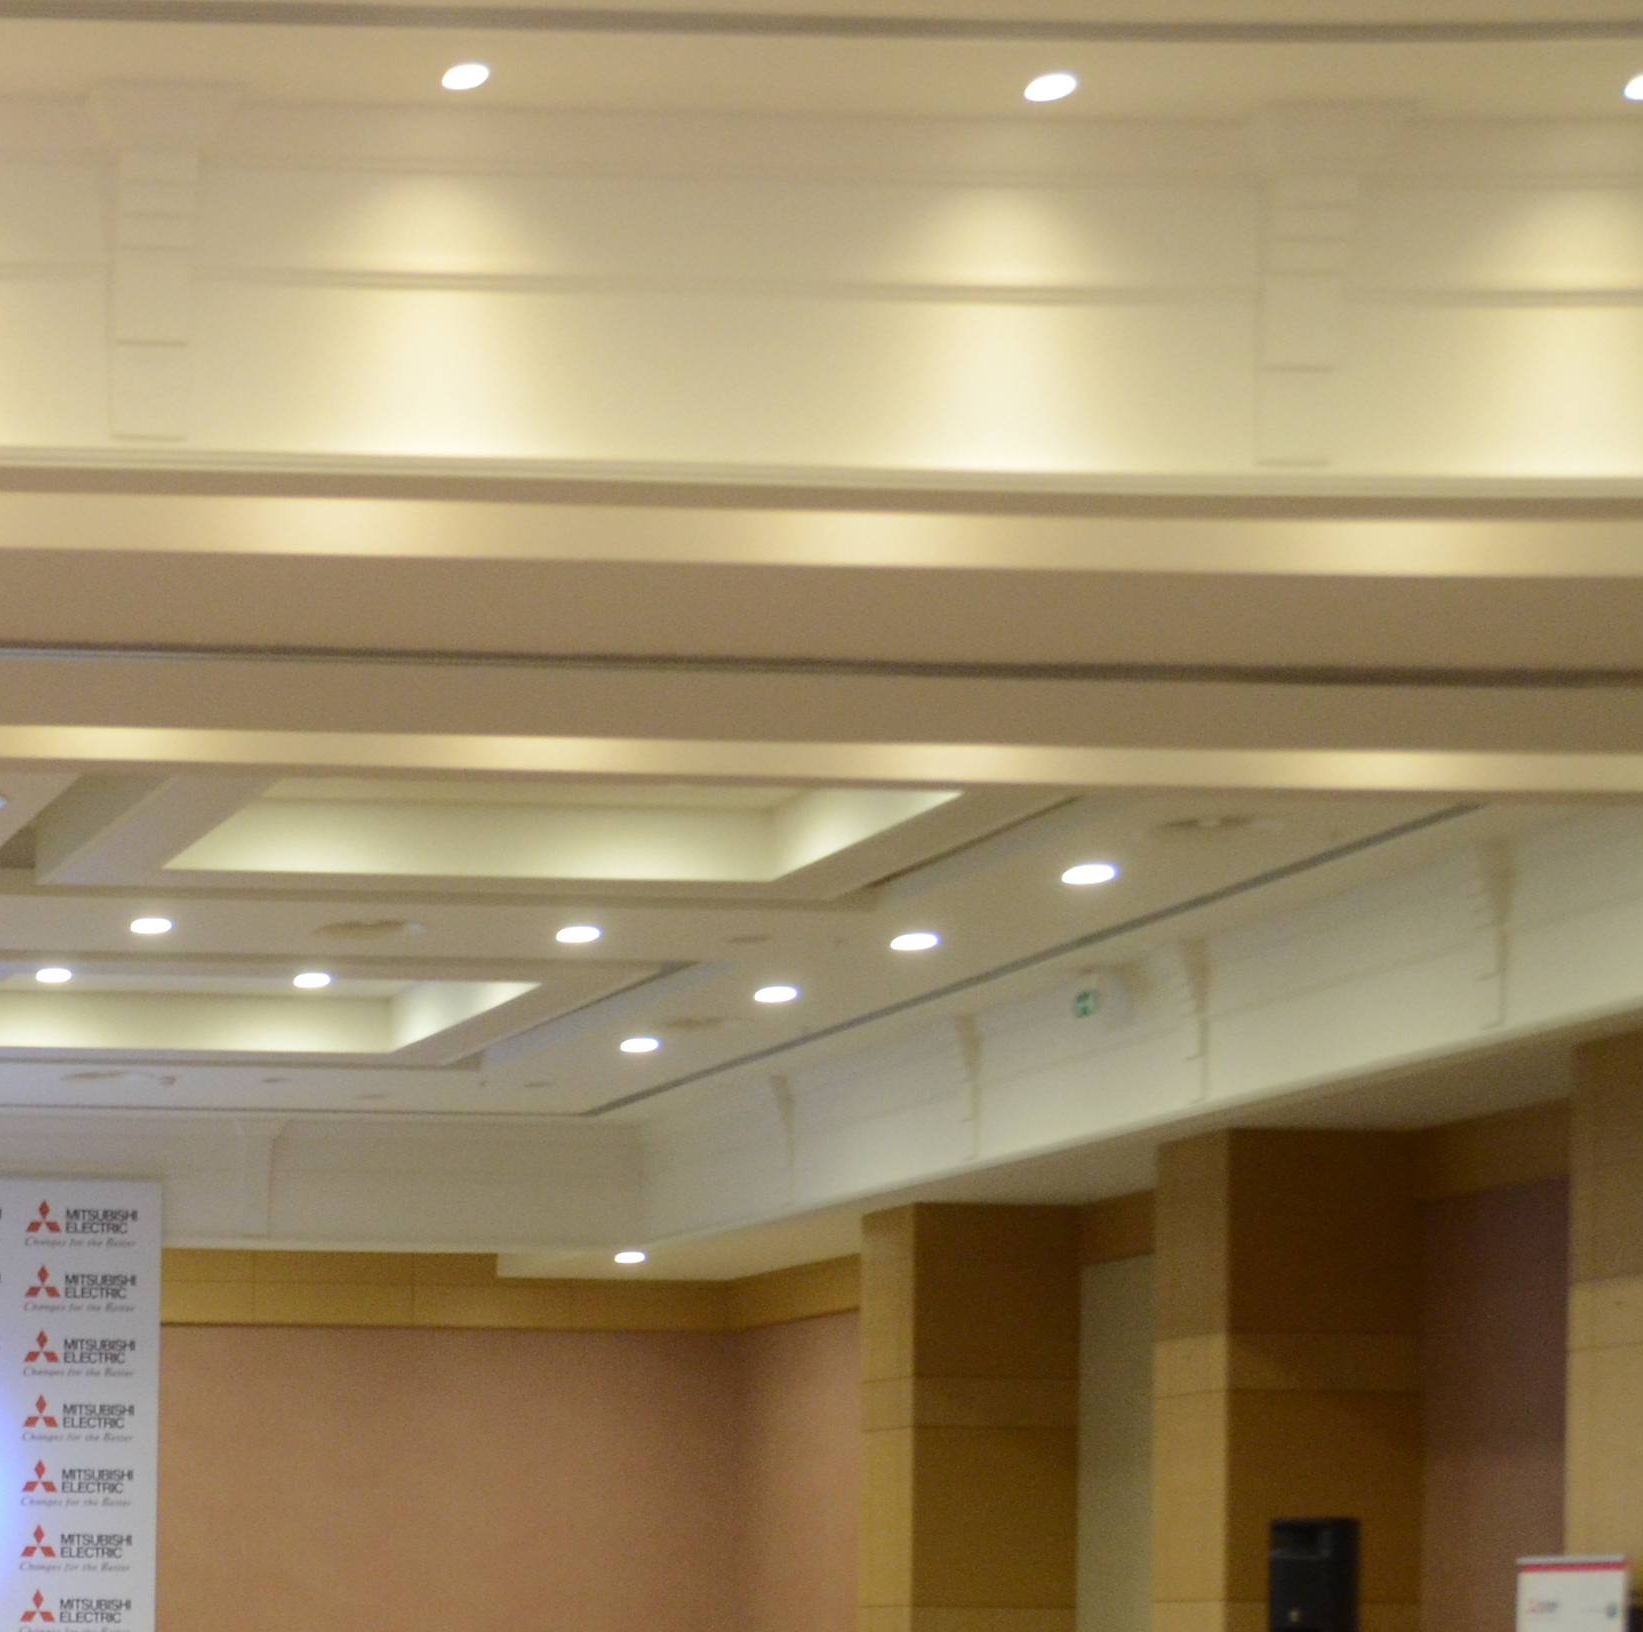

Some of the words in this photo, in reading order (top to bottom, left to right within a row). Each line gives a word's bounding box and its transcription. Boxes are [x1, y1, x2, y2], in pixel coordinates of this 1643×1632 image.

[65, 1208, 138, 1222] MITSUBISHI
[65, 1222, 129, 1235] ELECTRIC
[64, 1273, 137, 1287] MITSUBISHI
[64, 1287, 128, 1300] ELECTRIC
[63, 1338, 136, 1352] MITSUBISHI
[63, 1352, 127, 1365] ELECTRIC
[62, 1403, 135, 1417] MITSUBISHI
[62, 1417, 126, 1430] ELECTRIC
[61, 1467, 134, 1481] MITSUBISHI
[61, 1481, 125, 1494] ELECTRIC
[60, 1532, 133, 1546] MITSUBISHI
[60, 1546, 124, 1559] ELECTRIC
[59, 1597, 132, 1611] MITSUBISHI
[59, 1611, 123, 1624] ELECTRIC
